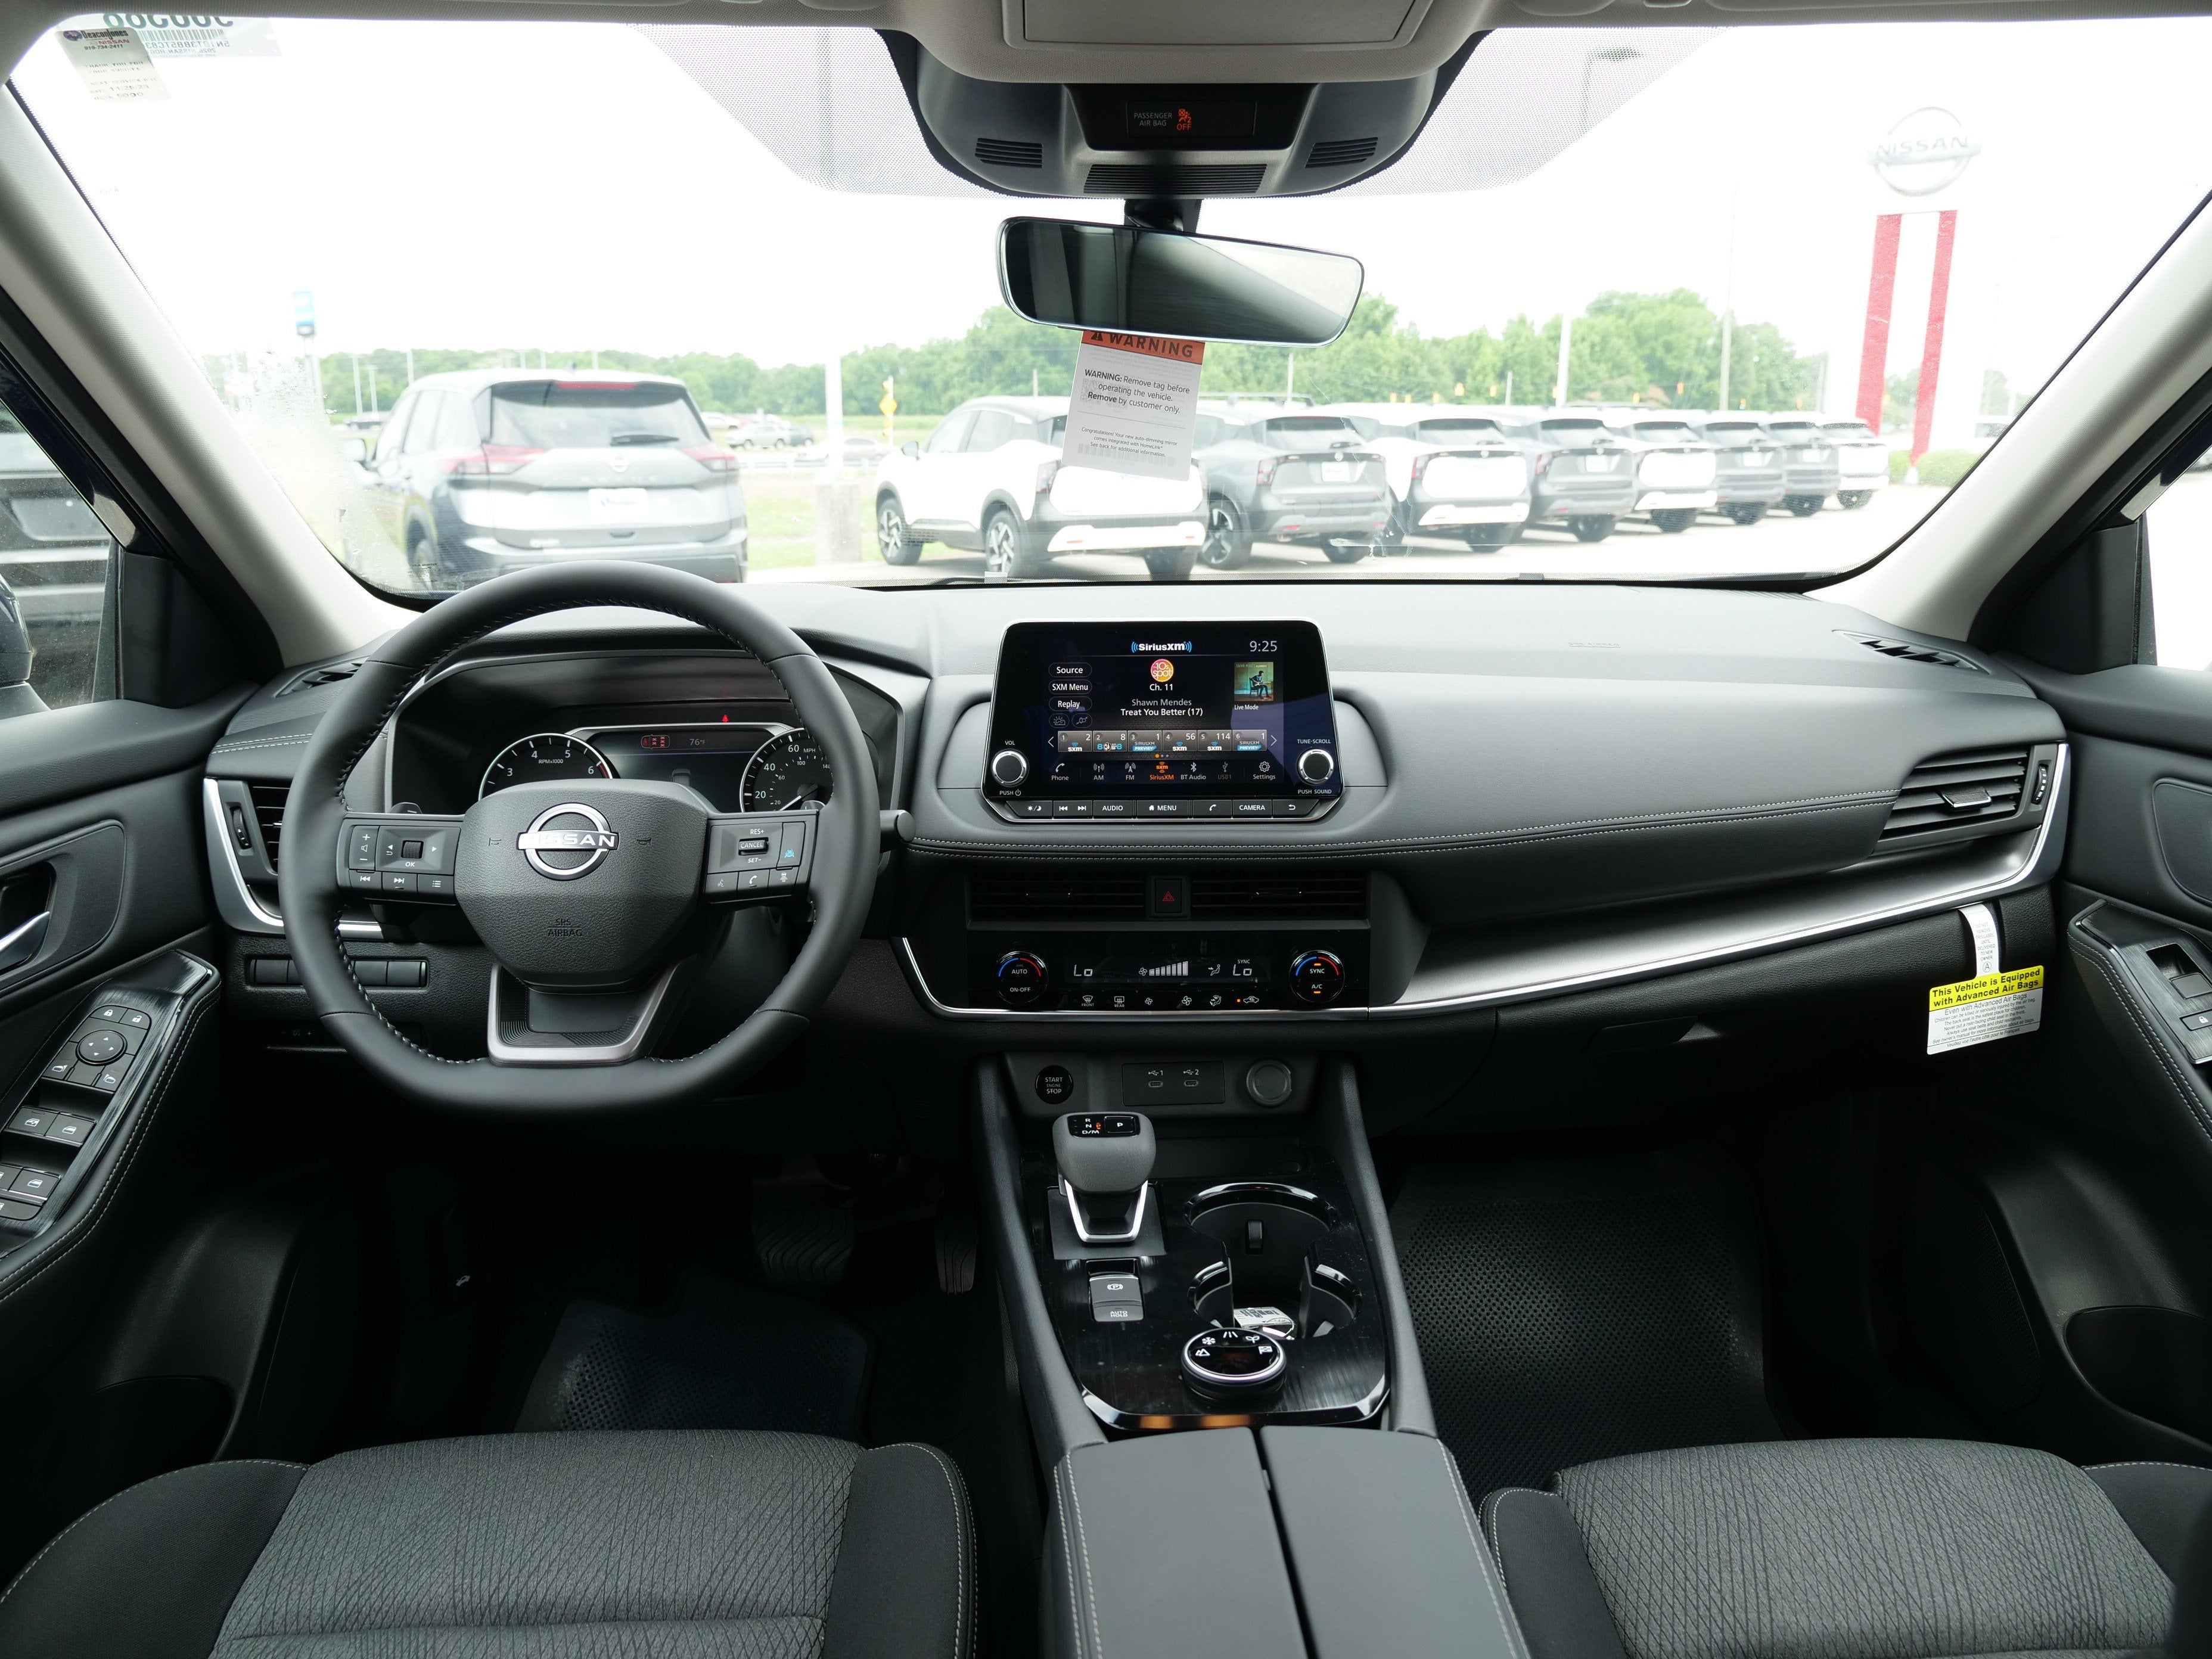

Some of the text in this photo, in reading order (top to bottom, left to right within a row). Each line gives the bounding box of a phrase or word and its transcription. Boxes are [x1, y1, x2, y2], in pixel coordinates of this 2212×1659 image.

[1877, 136, 1968, 156] NISSAN
[1110, 333, 1193, 358] WARNING
[1085, 369, 1190, 394] WARNING: Remove tag before
[1098, 384, 1173, 402] operating the vehicle.
[1088, 391, 1180, 415] Remove by customer only.
[1081, 427, 1114, 436] Congratulations!
[1135, 436, 1164, 445] auto-dimming
[1108, 437, 1129, 446] integrated
[1250, 641, 1277, 652] 9:25
[1058, 700, 1080, 709] Replay
[1188, 708, 1203, 717] (17)
[566, 750, 571, 758] 5
[507, 768, 513, 776] 3
[1074, 965, 1093, 977] Lo
[1233, 964, 1252, 976] Lo
[1933, 989, 1952, 998] This
[1955, 980, 1987, 993] Vehicle
[2000, 969, 2040, 983] Equipped
[1934, 979, 2039, 1007] with Advanced Air Bags
[1974, 998, 2002, 1009] Advanced
